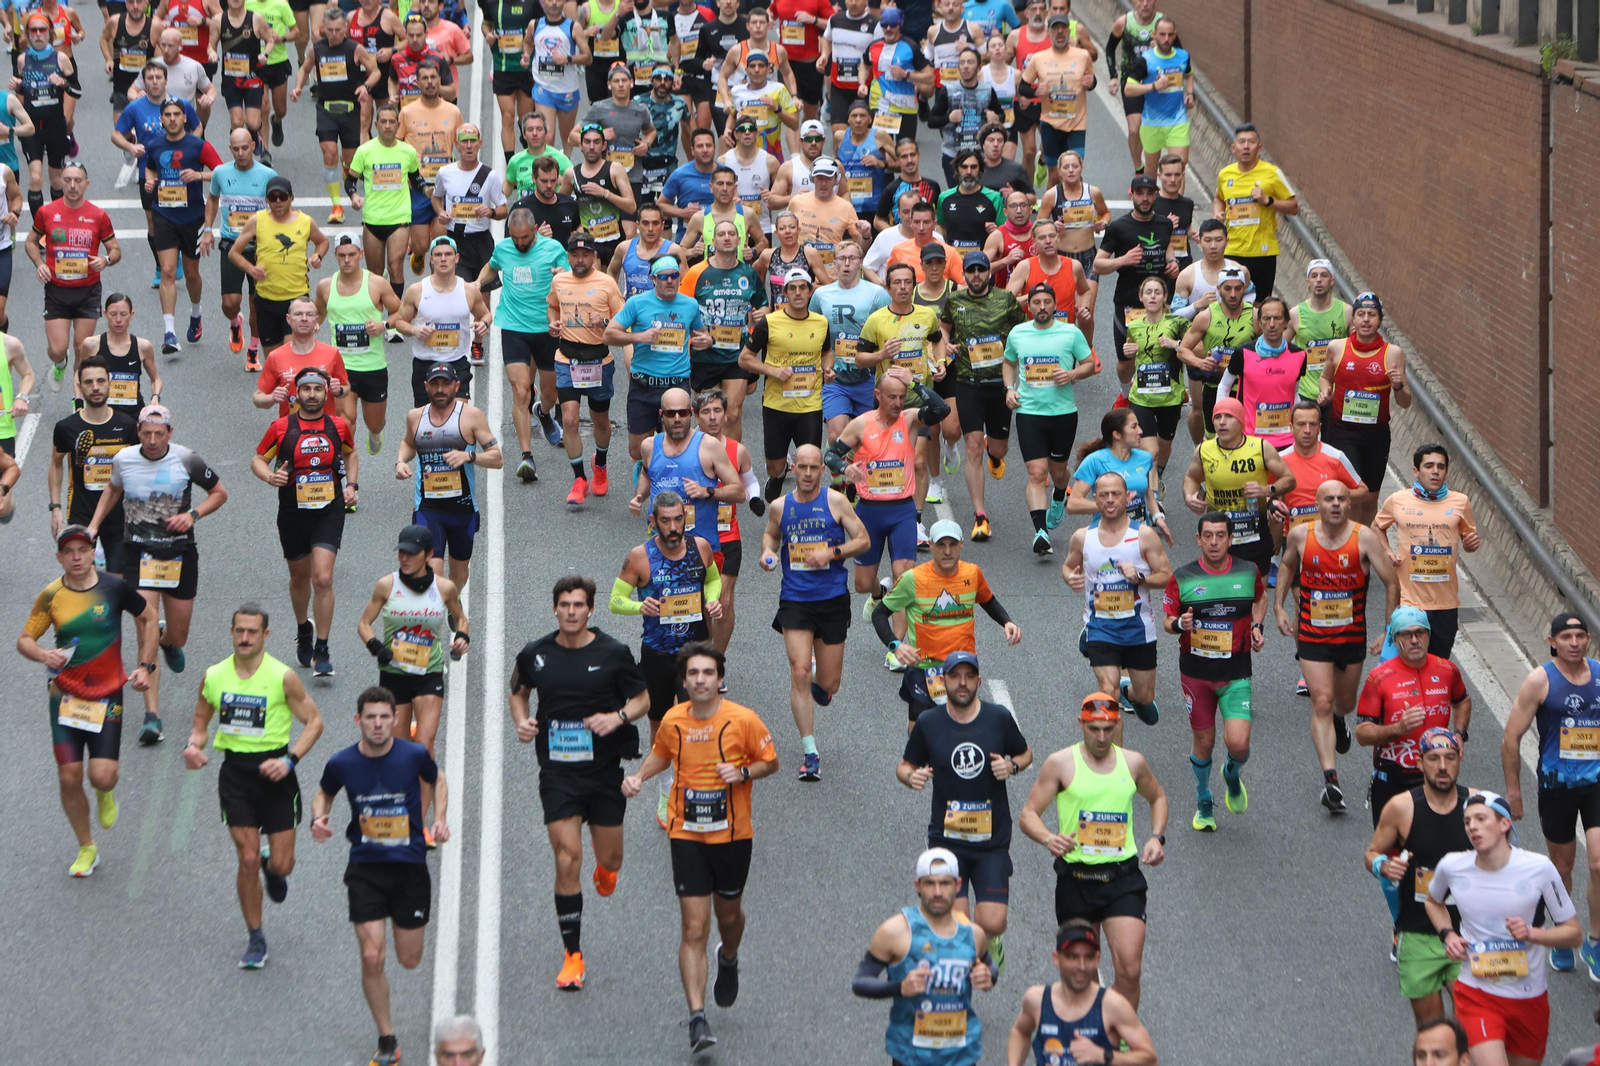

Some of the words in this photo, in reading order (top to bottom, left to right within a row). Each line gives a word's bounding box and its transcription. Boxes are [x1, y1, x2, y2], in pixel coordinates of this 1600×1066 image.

[978, 335, 996, 343] ZURICH
[900, 351, 919, 359] ZURICH
[794, 366, 814, 374] ZURICH
[1357, 391, 1377, 399] ZURICH
[1269, 403, 1288, 411] ZURICH
[1355, 401, 1368, 409] 1829
[879, 461, 901, 469] ZURICH
[1230, 458, 1256, 474] 428
[309, 475, 329, 483] ZURICH
[1234, 510, 1256, 519] ZURICH
[1432, 522, 1450, 530] Sevilla
[800, 535, 823, 543] ZURICH
[673, 586, 695, 595] ZURICH
[1106, 582, 1129, 591] ZURICH
[1324, 591, 1348, 599] ZURICH
[673, 599, 688, 607] 4892
[390, 607, 442, 618] maratón
[1204, 621, 1229, 629] ZURICH
[1203, 634, 1218, 642] 4878
[1200, 643, 1221, 651] ANTONIO
[235, 696, 263, 705] ZURICH
[695, 791, 722, 800] ZURICH
[695, 805, 712, 813] 3341
[962, 801, 987, 811] ZURICH
[375, 806, 402, 816] ZURICH
[1095, 814, 1122, 822] ZURICH
[1489, 940, 1520, 951] ZURICH
[935, 1001, 964, 1012] ZURICH
